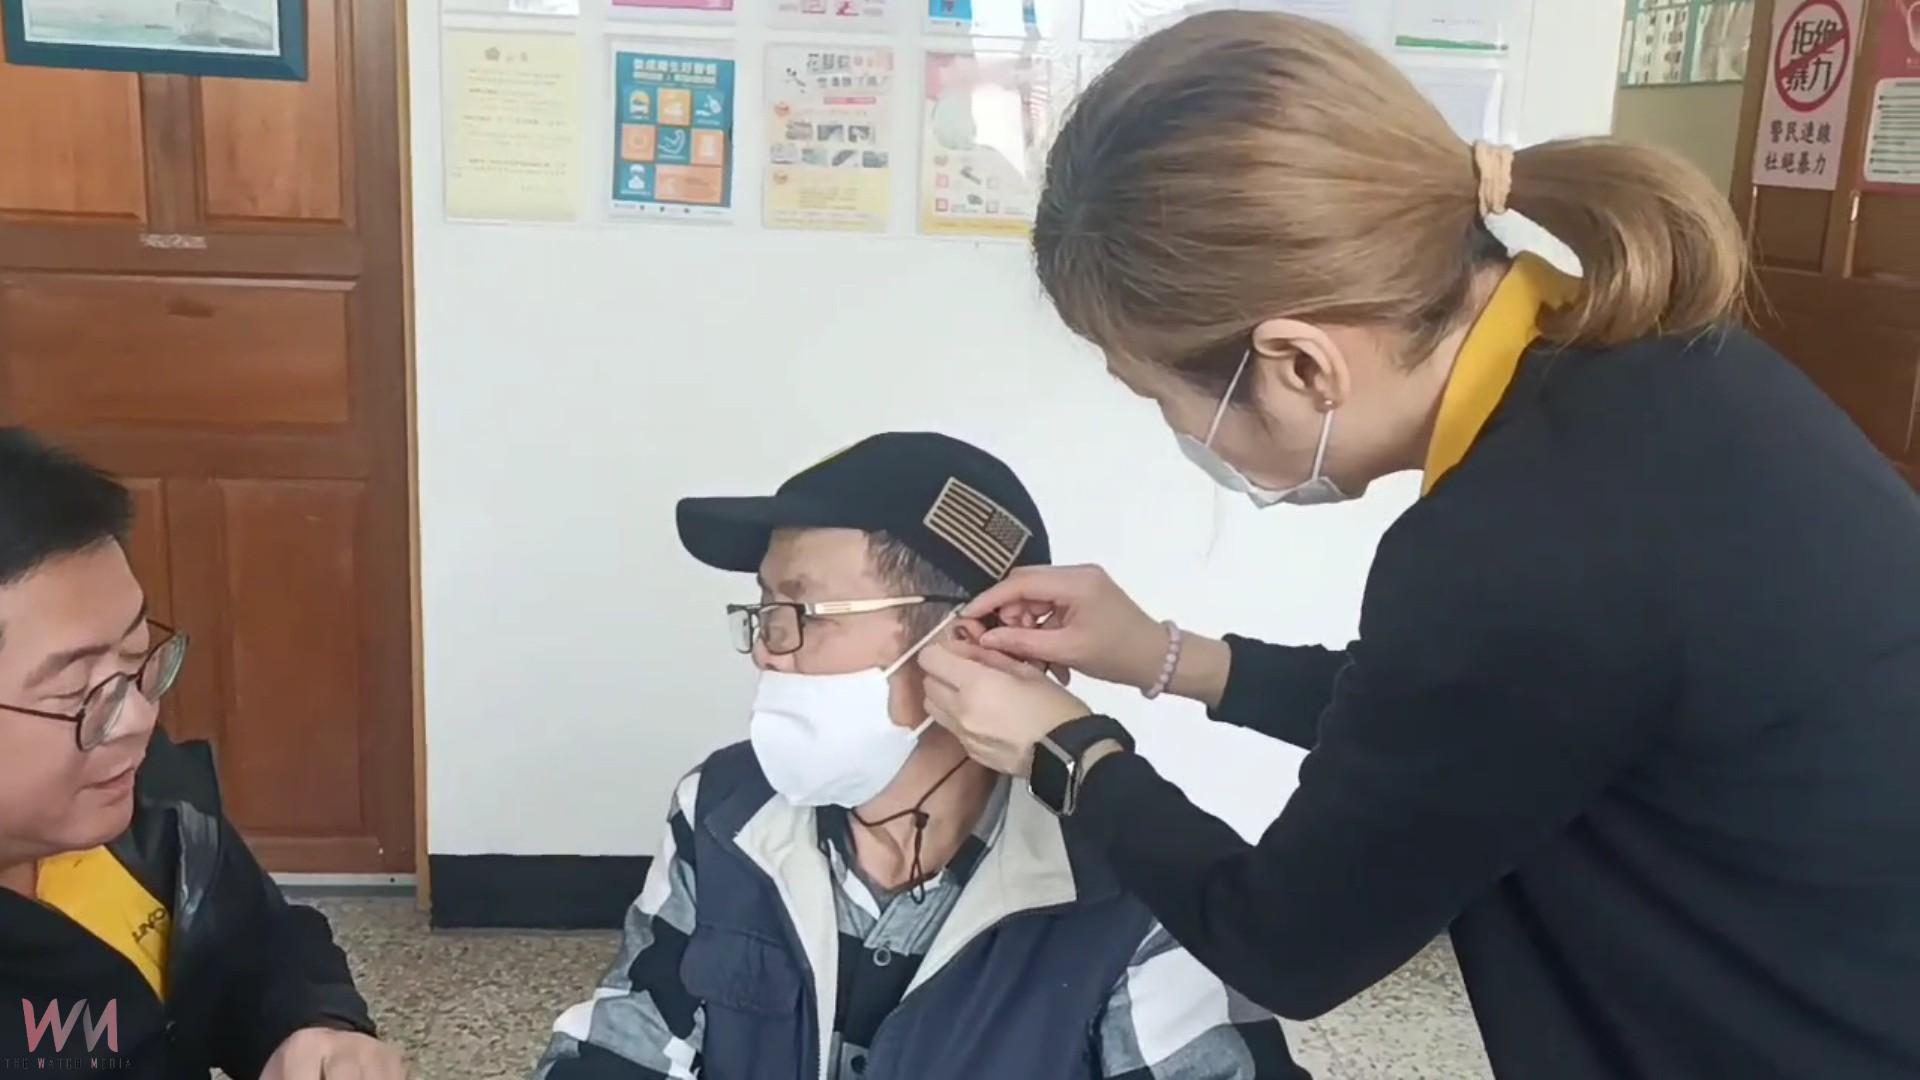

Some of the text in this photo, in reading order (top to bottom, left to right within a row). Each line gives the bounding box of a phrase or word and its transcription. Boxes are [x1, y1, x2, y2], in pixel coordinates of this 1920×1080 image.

[1791, 19, 1837, 54] 拒絕
[1770, 119, 1831, 144] 警民連線
[1764, 150, 1826, 175] 杜絕暴力
